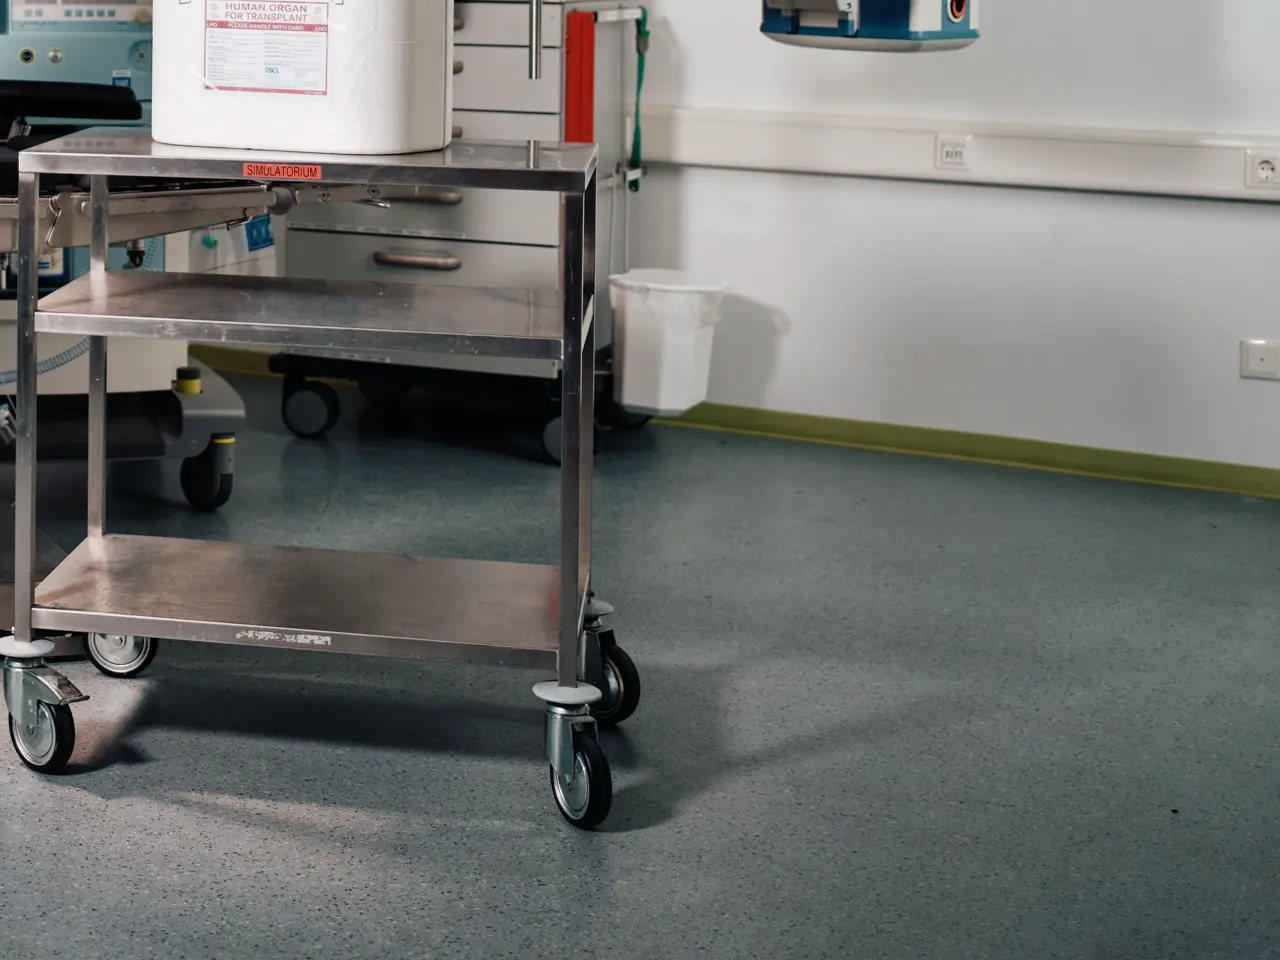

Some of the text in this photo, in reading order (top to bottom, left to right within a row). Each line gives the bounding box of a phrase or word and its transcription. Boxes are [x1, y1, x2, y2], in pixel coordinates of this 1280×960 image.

[225, 2, 307, 13] HUMAN ORGAN
[224, 11, 244, 20] FOR
[246, 12, 308, 22] TRANSPLANT
[246, 164, 318, 178] SIMULATORIUM
